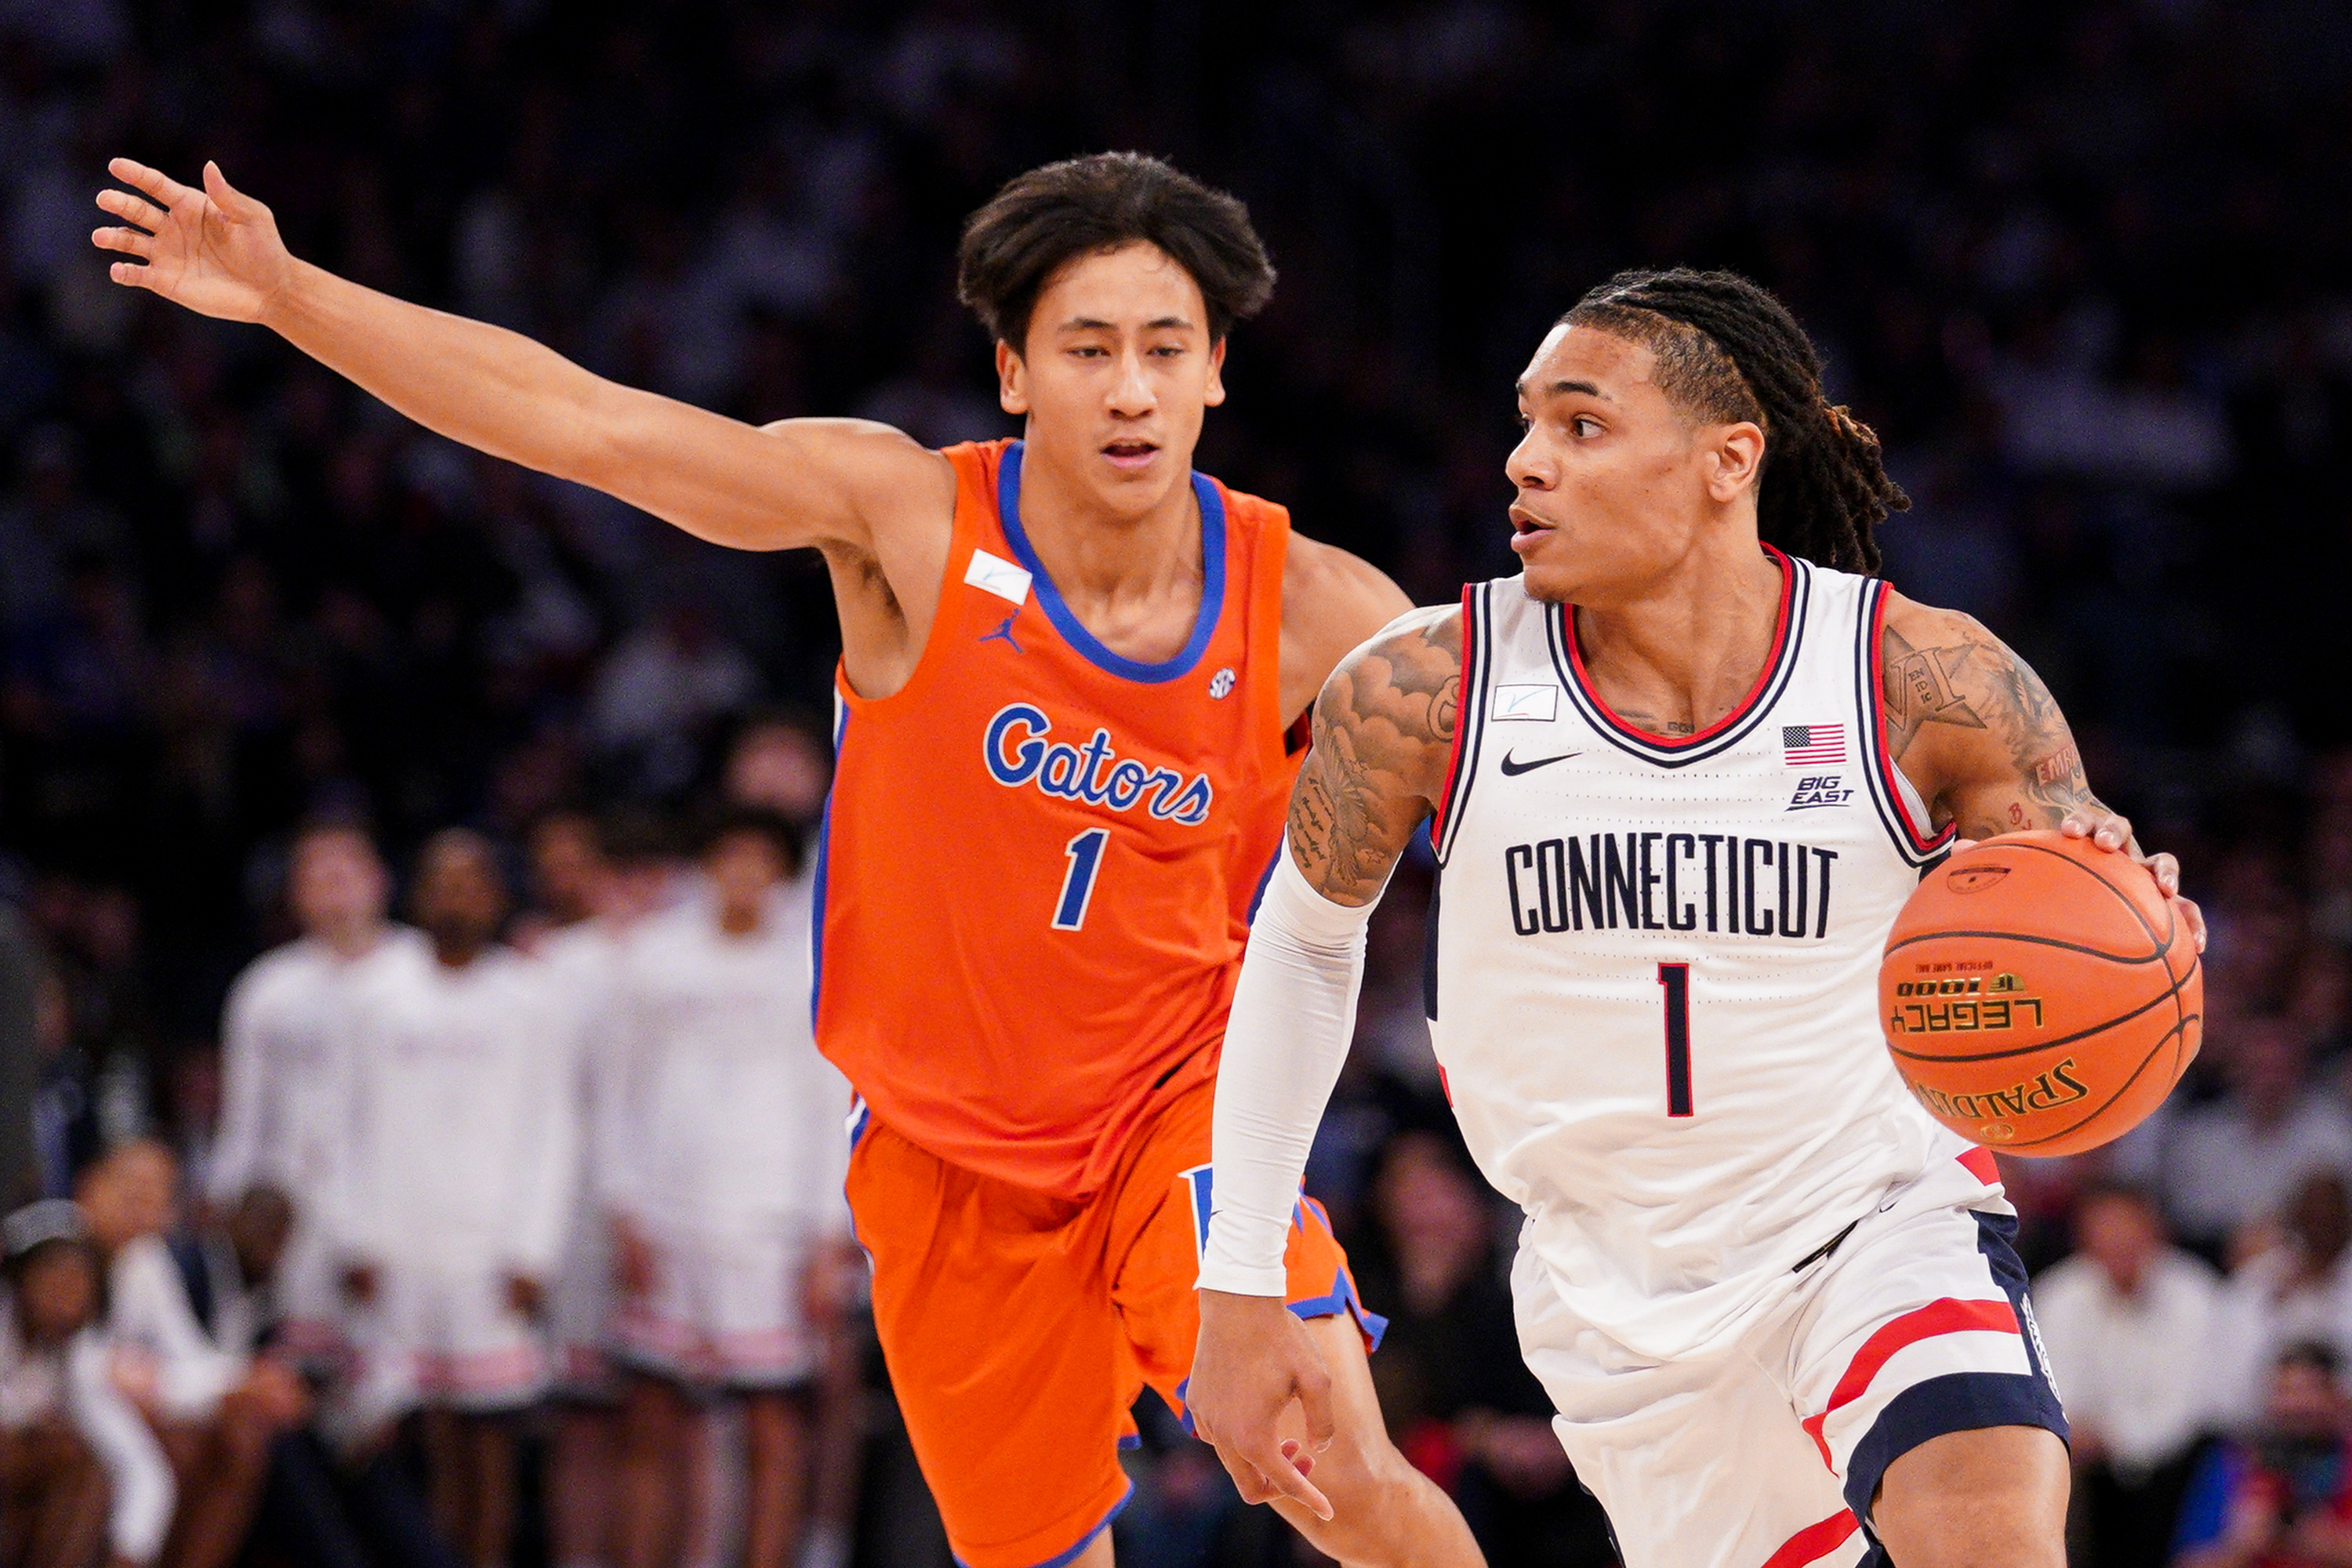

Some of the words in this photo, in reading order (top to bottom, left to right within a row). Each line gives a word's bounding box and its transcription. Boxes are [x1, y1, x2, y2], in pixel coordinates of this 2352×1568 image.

[983, 702, 1213, 826] Gators
[1797, 776, 1842, 791] BIG
[1791, 789, 1854, 804] EAST
[1051, 827, 1110, 931] 1
[1504, 833, 1838, 939] CONNECTICUT
[1890, 998, 2044, 1034] LEGACY
[1896, 977, 1982, 997] 1000
[1658, 962, 1693, 1117] 1
[1898, 1058, 2089, 1120] SPALDIN
